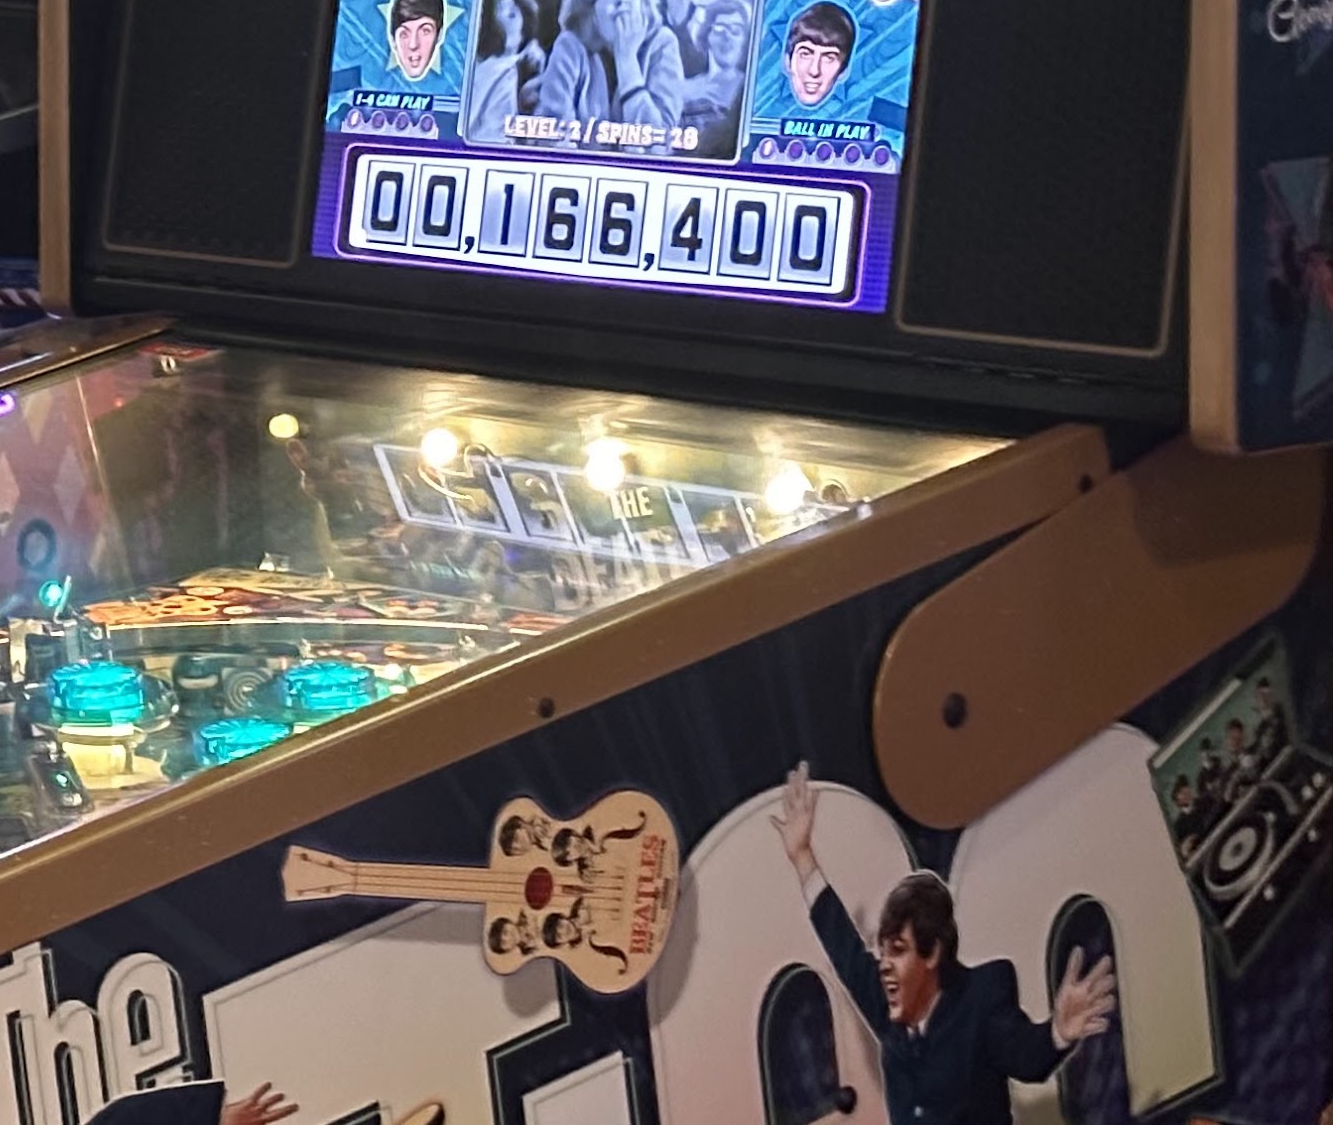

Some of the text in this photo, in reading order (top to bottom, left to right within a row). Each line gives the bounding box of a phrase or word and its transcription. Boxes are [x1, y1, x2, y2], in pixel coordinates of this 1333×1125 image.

[400, 95, 431, 110] PLAY
[784, 120, 871, 140] BALL IN PLAY
[369, 167, 829, 272] 00,166,400
[609, 486, 654, 521] THE
[629, 834, 660, 954] BEATLES
